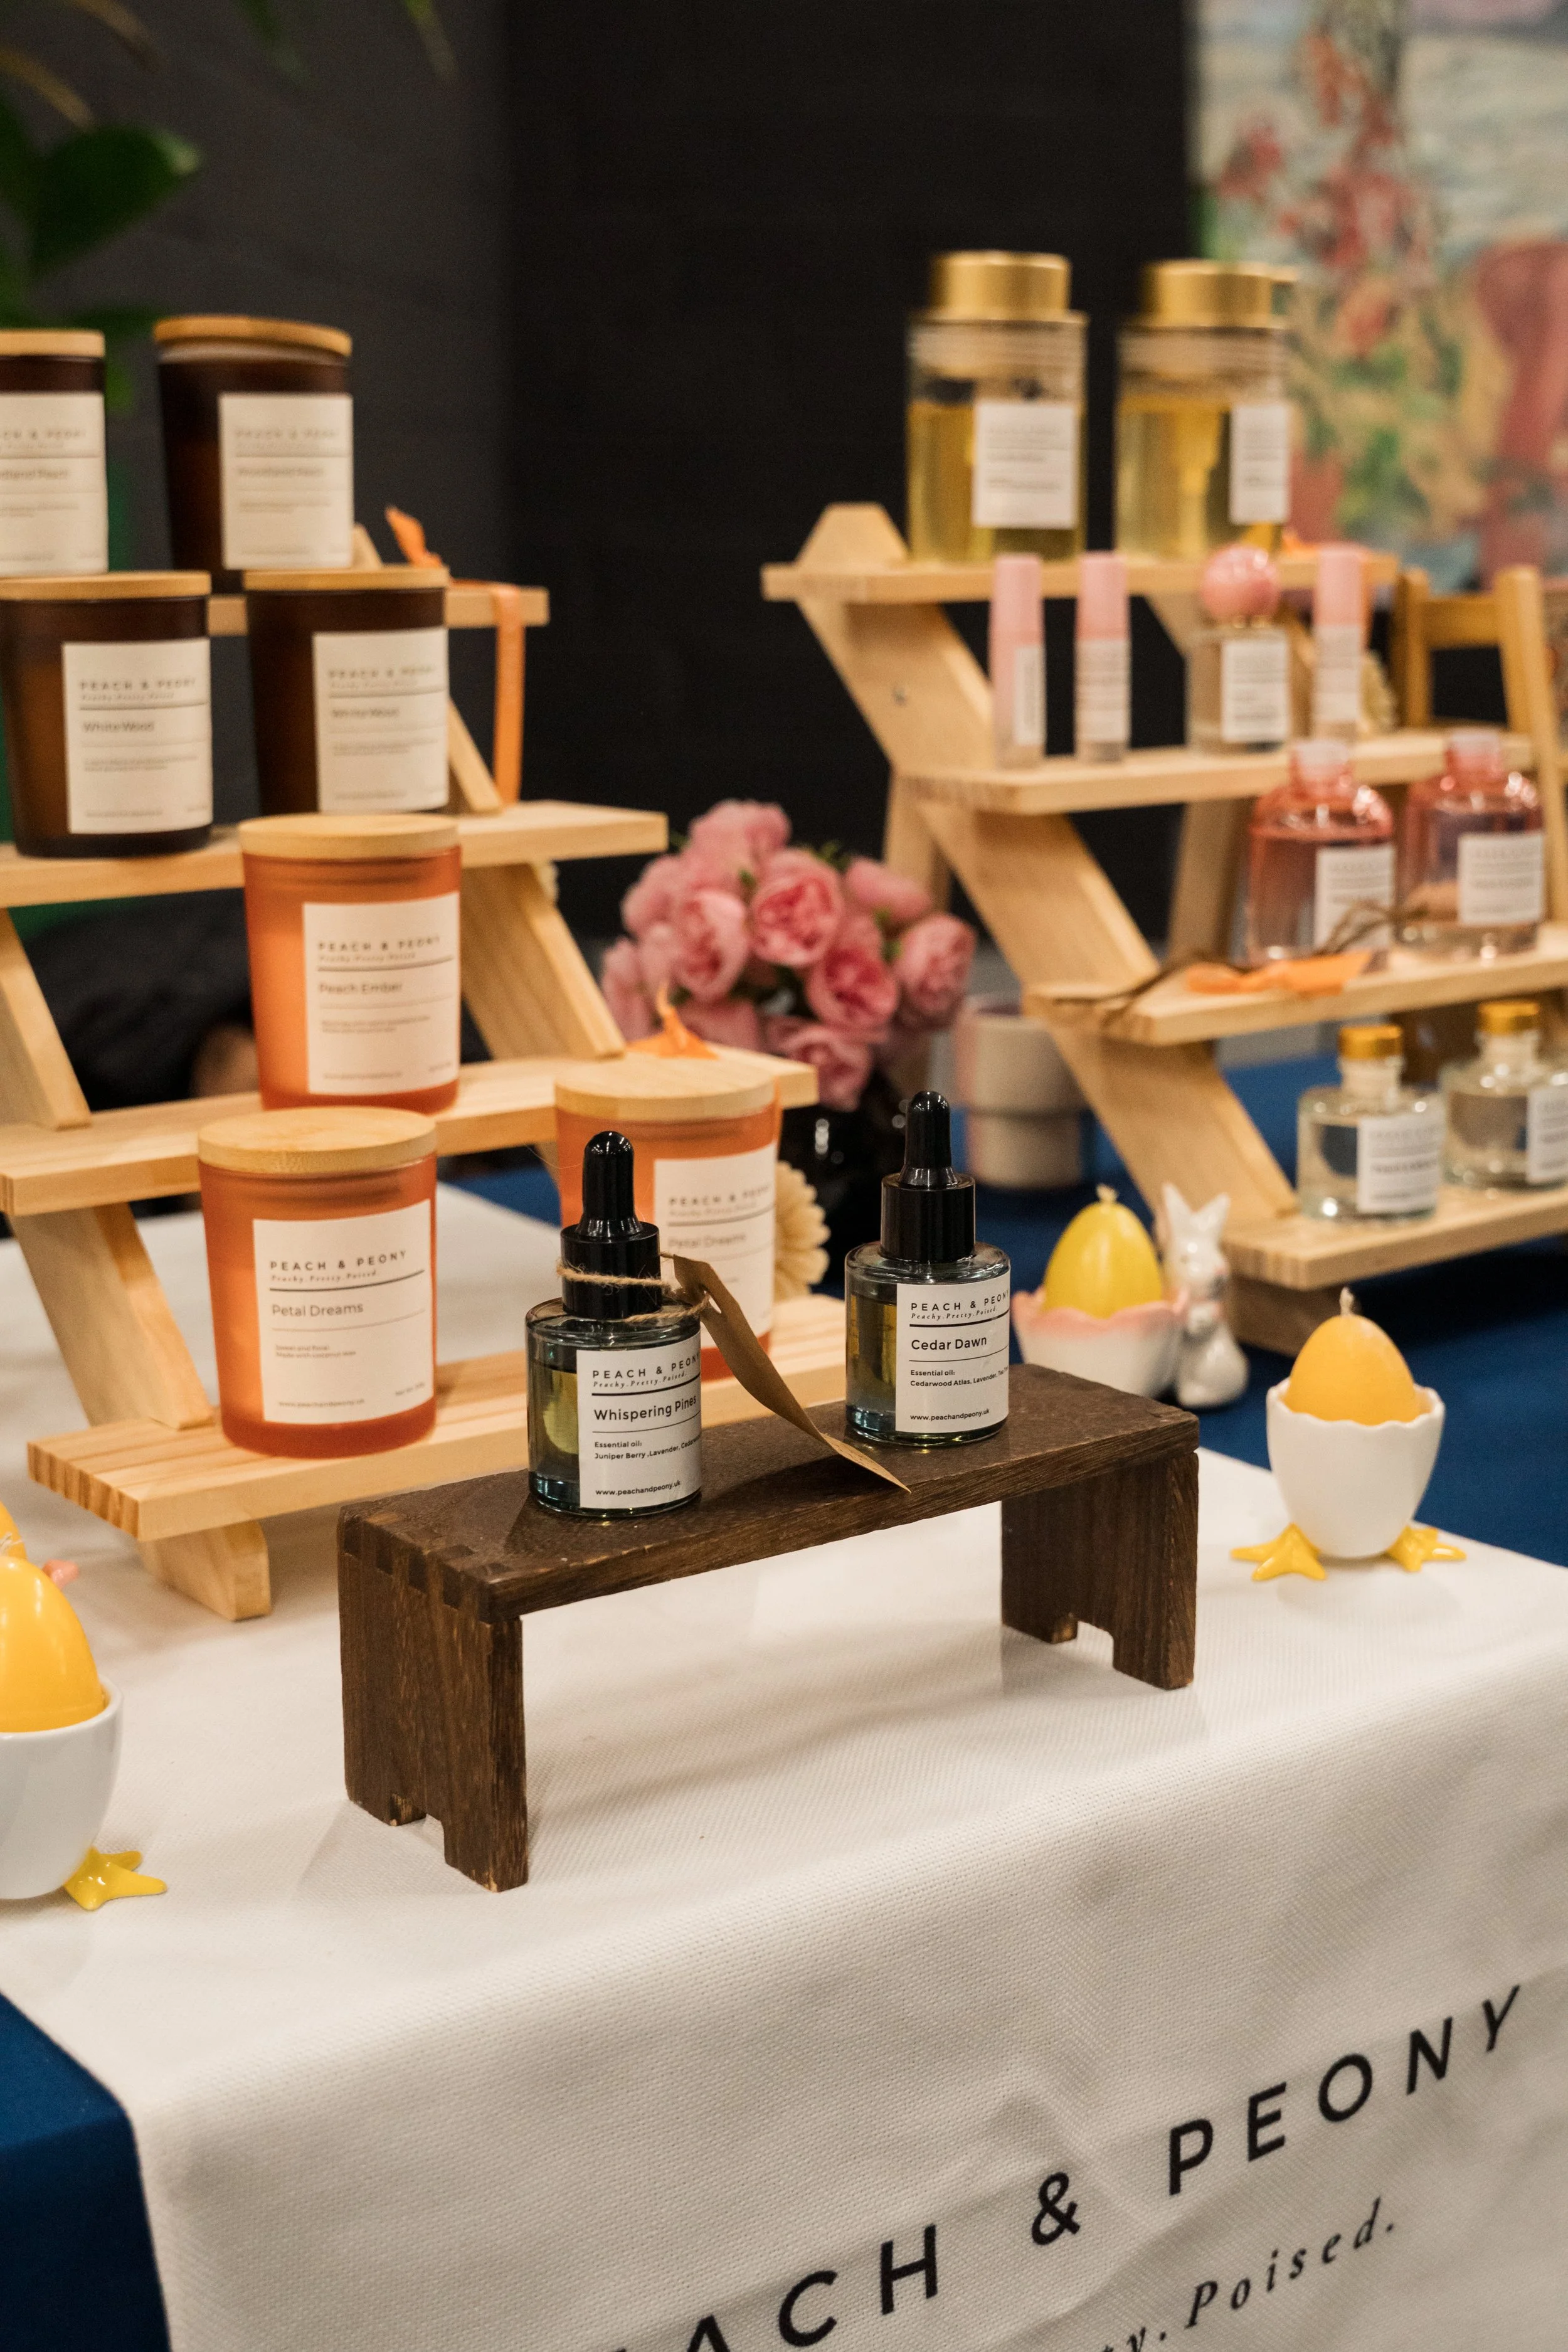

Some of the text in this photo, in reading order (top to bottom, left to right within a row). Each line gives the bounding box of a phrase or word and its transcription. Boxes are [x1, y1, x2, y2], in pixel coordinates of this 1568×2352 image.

[318, 941, 371, 951] PEACH
[270, 1250, 406, 1271] PEACH & PEONY
[272, 1303, 364, 1317] Petal Dreams
[911, 1302, 961, 1311] PEACH
[911, 1337, 987, 1350] Cedar Dawn
[593, 1369, 646, 1379] PEACH
[656, 1366, 662, 1375] &
[594, 1395, 697, 1422] Whispering Pines
[910, 1408, 990, 1422] www.peachandpeony.uk
[595, 1480, 681, 1496] www.peachandpeony.uk
[1031, 2171, 1080, 2245] &
[1168, 1985, 1520, 2196] PEONY
